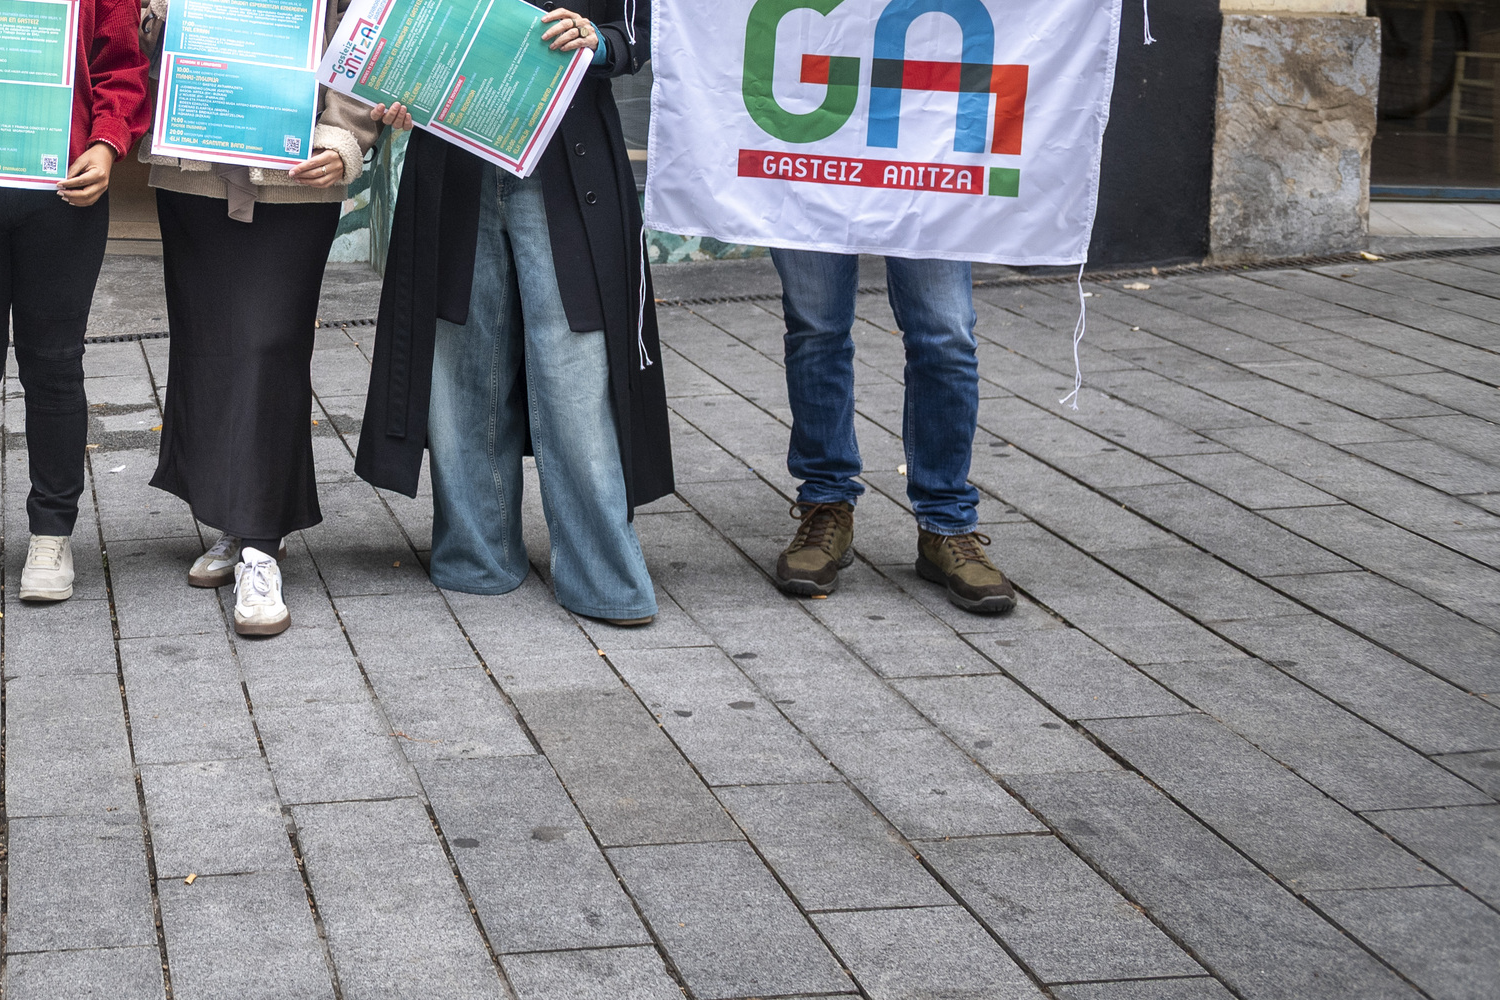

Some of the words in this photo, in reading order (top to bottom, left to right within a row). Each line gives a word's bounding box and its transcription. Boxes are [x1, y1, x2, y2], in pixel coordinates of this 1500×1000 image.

[331, 40, 353, 75] Gasteiz
[762, 155, 862, 183] GASTEIZ
[883, 165, 972, 191] ANITZA
